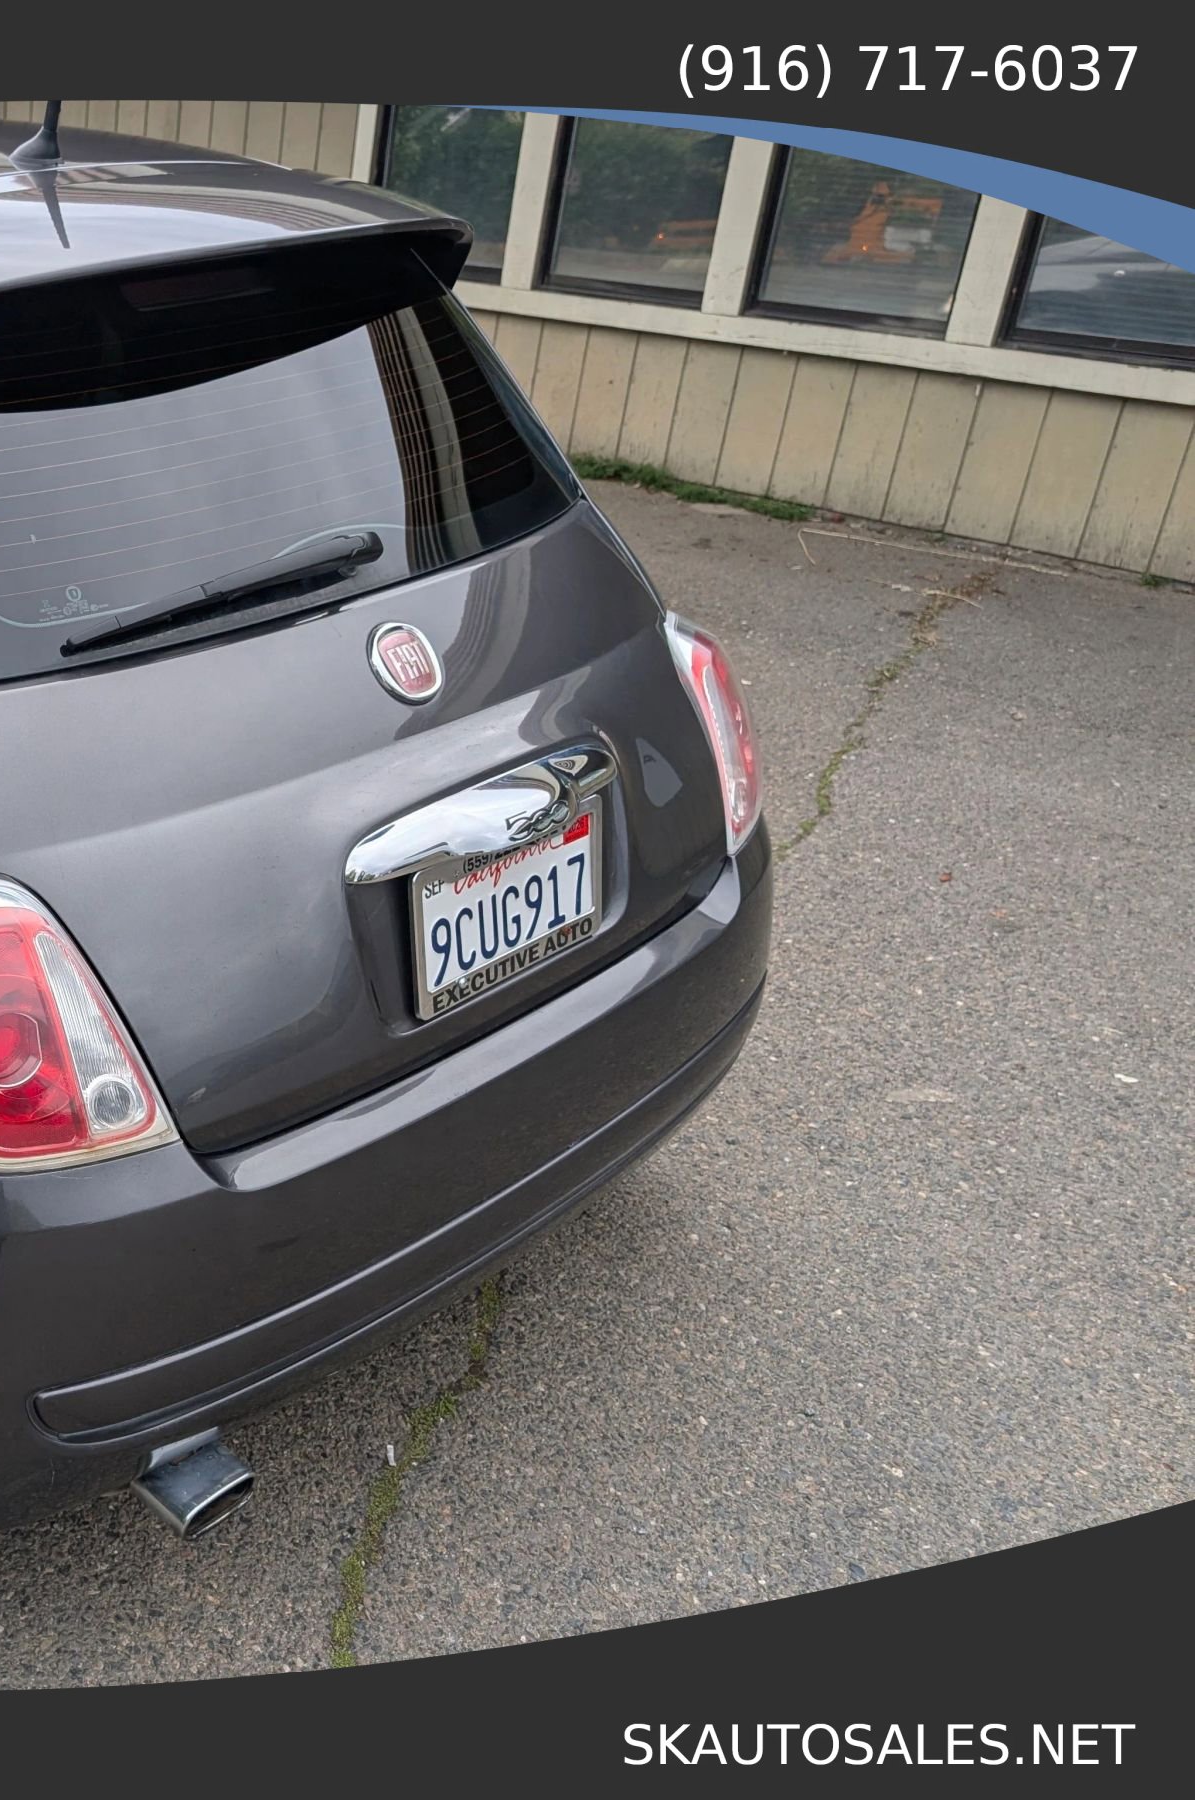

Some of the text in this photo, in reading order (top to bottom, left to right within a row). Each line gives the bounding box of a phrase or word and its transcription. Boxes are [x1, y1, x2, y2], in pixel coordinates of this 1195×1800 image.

[386, 641, 430, 683] FIAT
[505, 800, 570, 842] 500
[431, 853, 586, 987] 9CUG917
[432, 918, 593, 1014] EXECUTIVE AUTO
